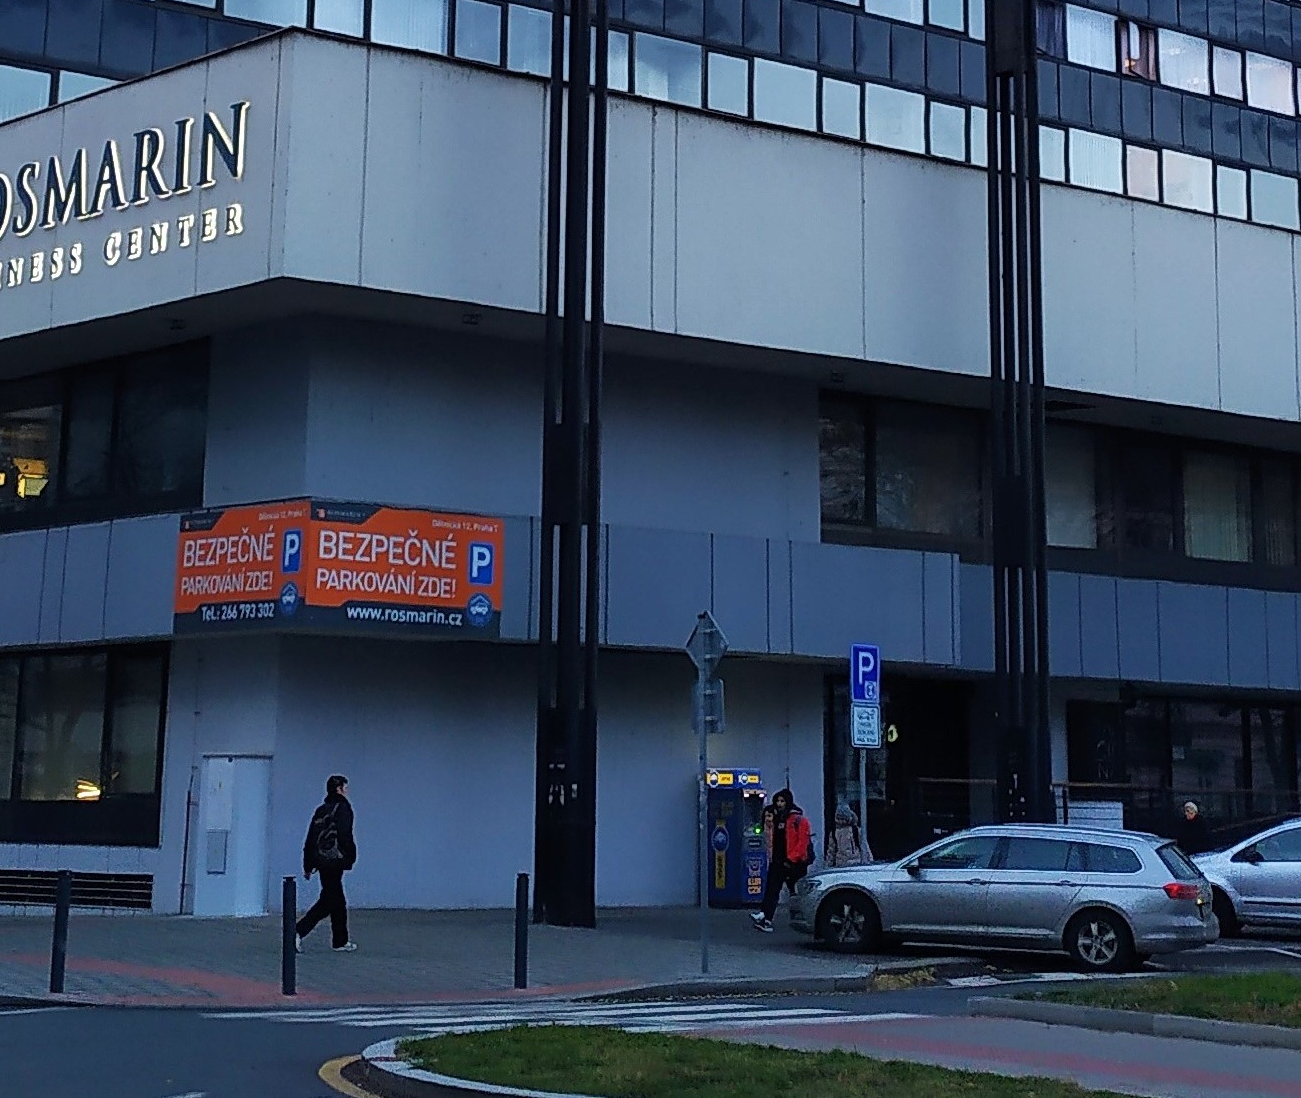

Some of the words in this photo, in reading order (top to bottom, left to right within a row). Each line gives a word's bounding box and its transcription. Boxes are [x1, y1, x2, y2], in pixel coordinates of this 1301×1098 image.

[103, 202, 246, 267] CENTER
[183, 524, 276, 567] BEZPEČNÉ
[284, 533, 300, 568] P
[318, 529, 457, 570] BEZPEČNÉ
[471, 545, 491, 579] P
[181, 567, 246, 596] PARKOVÁNÍ
[245, 571, 273, 592] ZDE!
[316, 567, 417, 595] PARKOVÁNÍ
[417, 575, 456, 599] ZDE!
[221, 604, 238, 620] 266
[239, 603, 257, 619] 793
[257, 602, 275, 619] 302
[346, 606, 463, 627] www.rosmarin.cz
[858, 651, 875, 686] P
